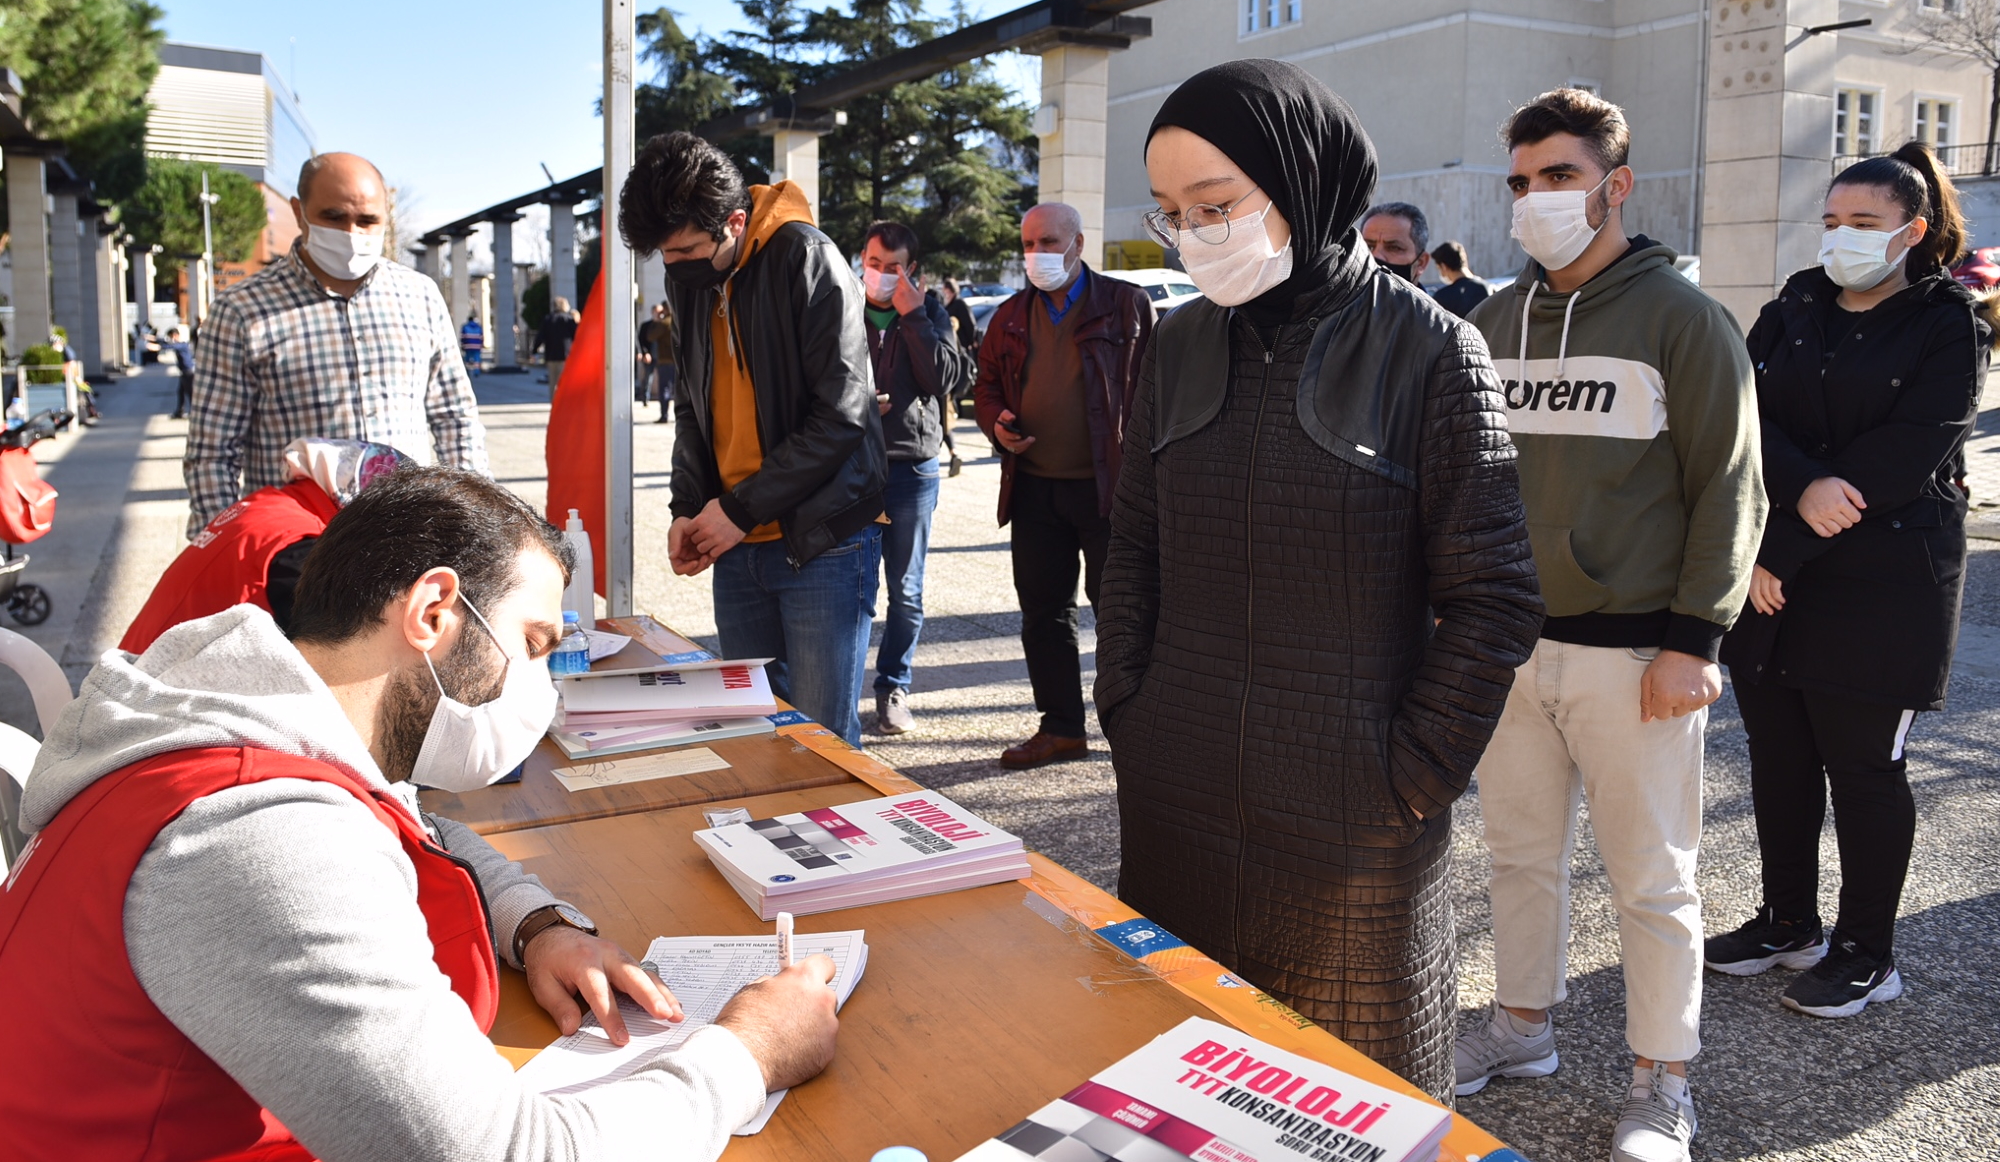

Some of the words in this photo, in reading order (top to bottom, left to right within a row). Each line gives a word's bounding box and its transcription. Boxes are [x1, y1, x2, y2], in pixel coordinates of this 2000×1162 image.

[1500, 378, 1617, 413] prem
[875, 808, 906, 821] TYT
[892, 798, 991, 842] BİYOLOJİ
[1179, 1039, 1392, 1135] BİYOLOJİ
[1176, 1067, 1229, 1097] TYT
[1216, 1086, 1388, 1162] KONSANTRASYON
[1275, 1133, 1314, 1155] SORU
